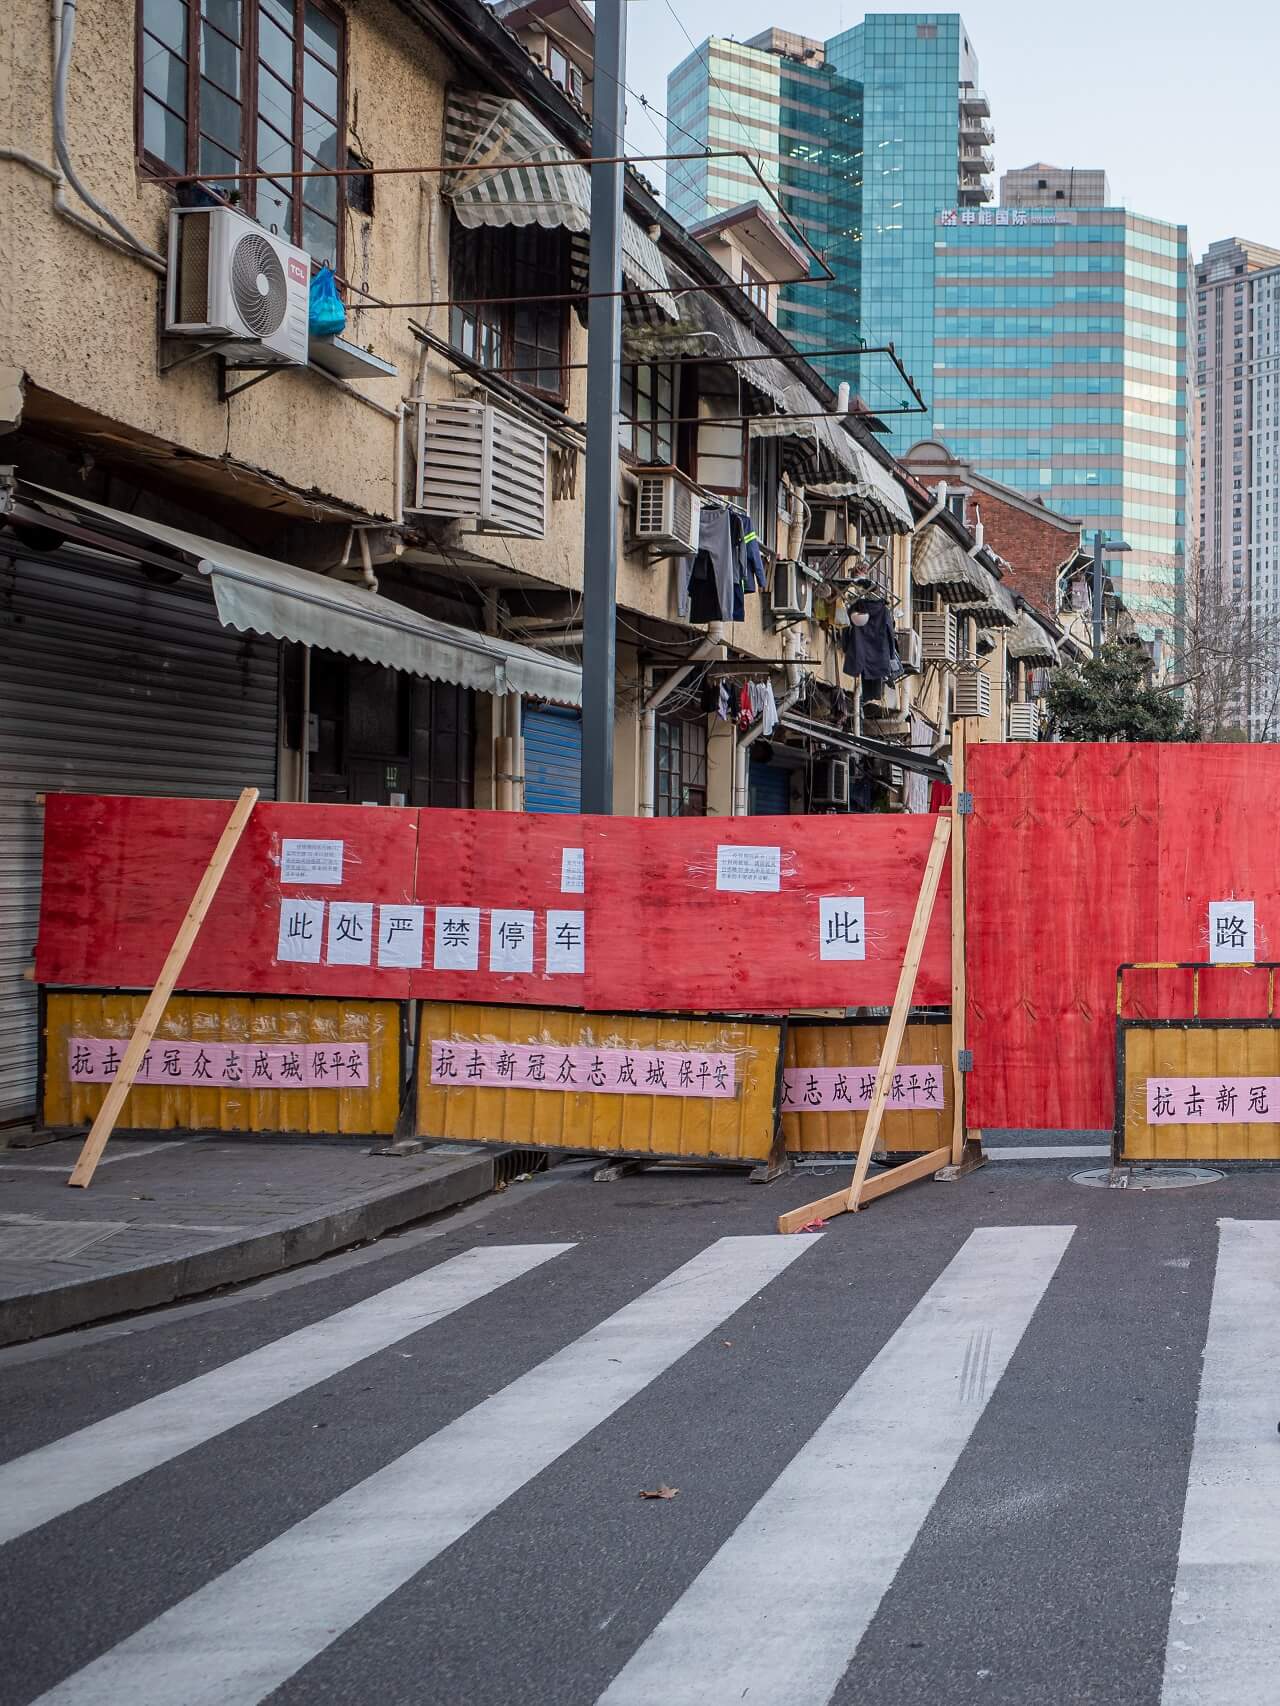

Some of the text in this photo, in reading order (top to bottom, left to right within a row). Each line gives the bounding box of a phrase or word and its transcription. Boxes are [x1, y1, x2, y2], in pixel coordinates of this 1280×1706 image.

[961, 209, 1028, 226] 申能国际
[290, 263, 305, 279] TCL
[288, 911, 582, 951] 此处严禁停车
[825, 911, 860, 945] 此
[1216, 915, 1249, 948] 路
